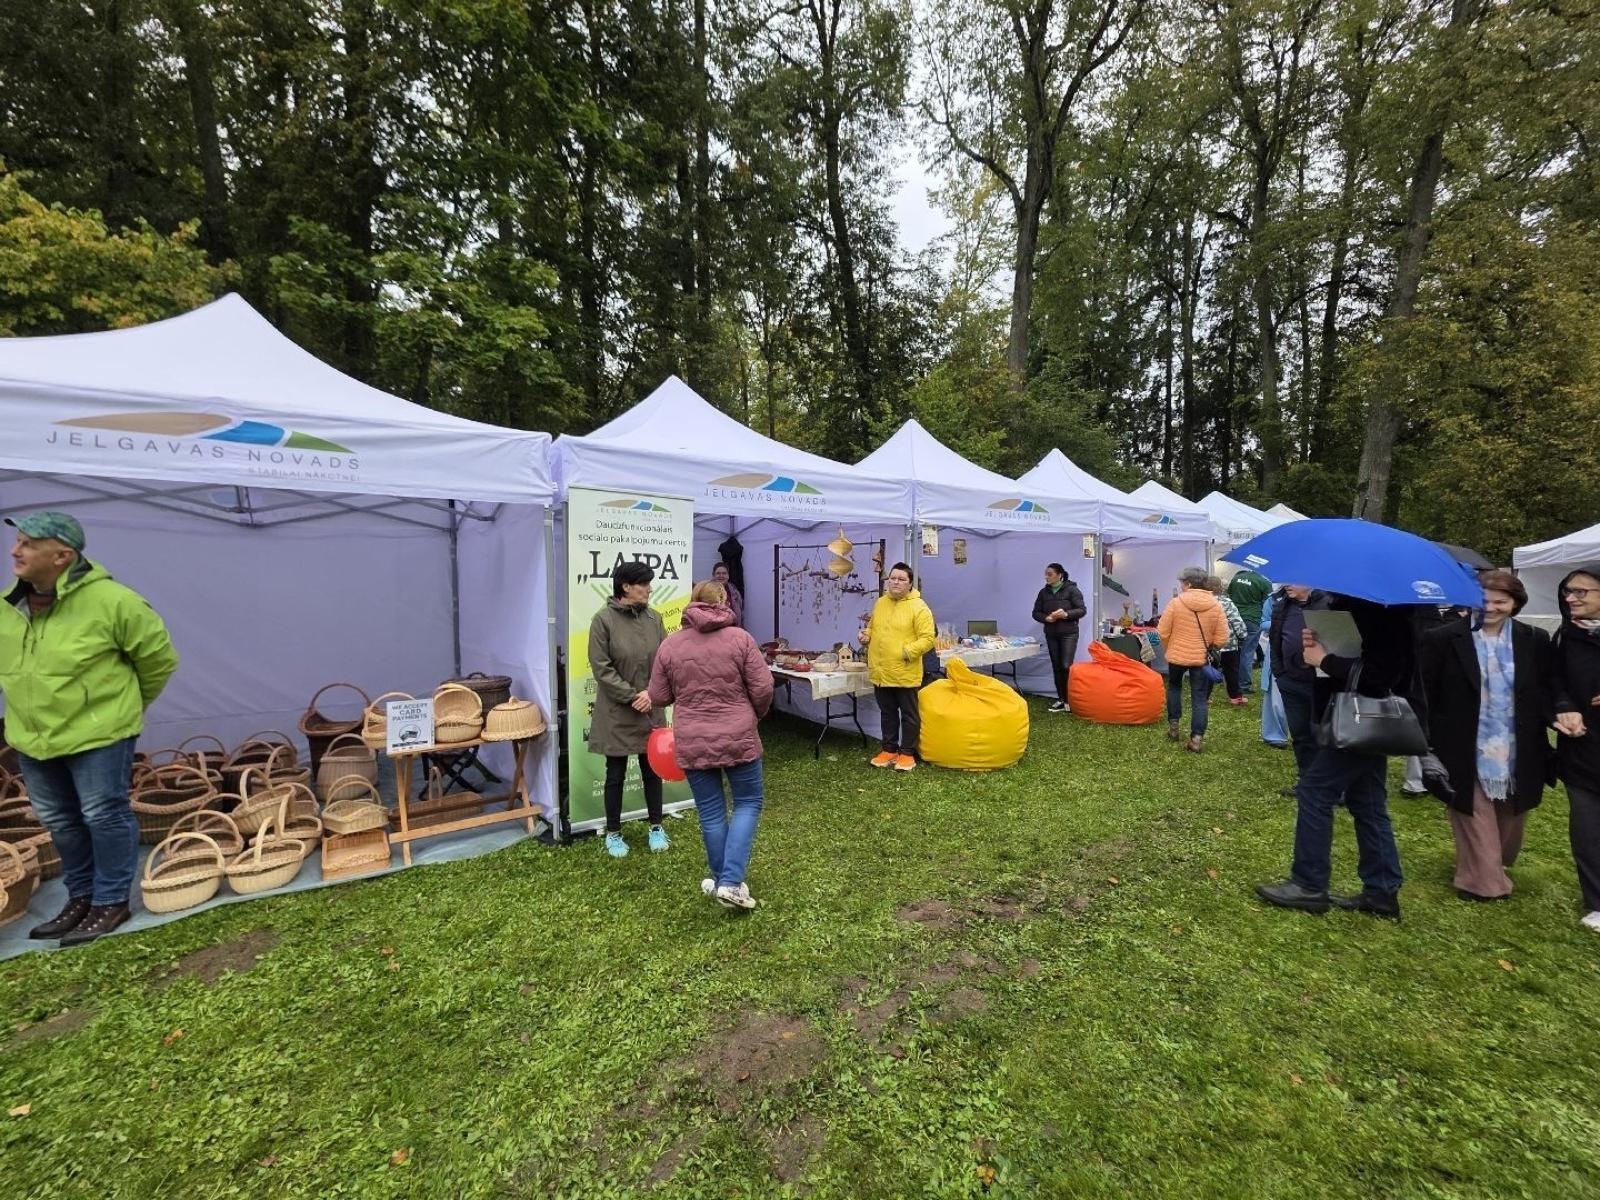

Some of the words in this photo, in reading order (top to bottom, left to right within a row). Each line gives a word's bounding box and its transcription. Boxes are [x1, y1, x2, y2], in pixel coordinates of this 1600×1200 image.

[46, 431, 225, 457] JELGAVAS
[248, 449, 360, 470] NOVADS
[704, 488, 772, 501] JELGAVAS
[780, 494, 827, 506] NOVADS
